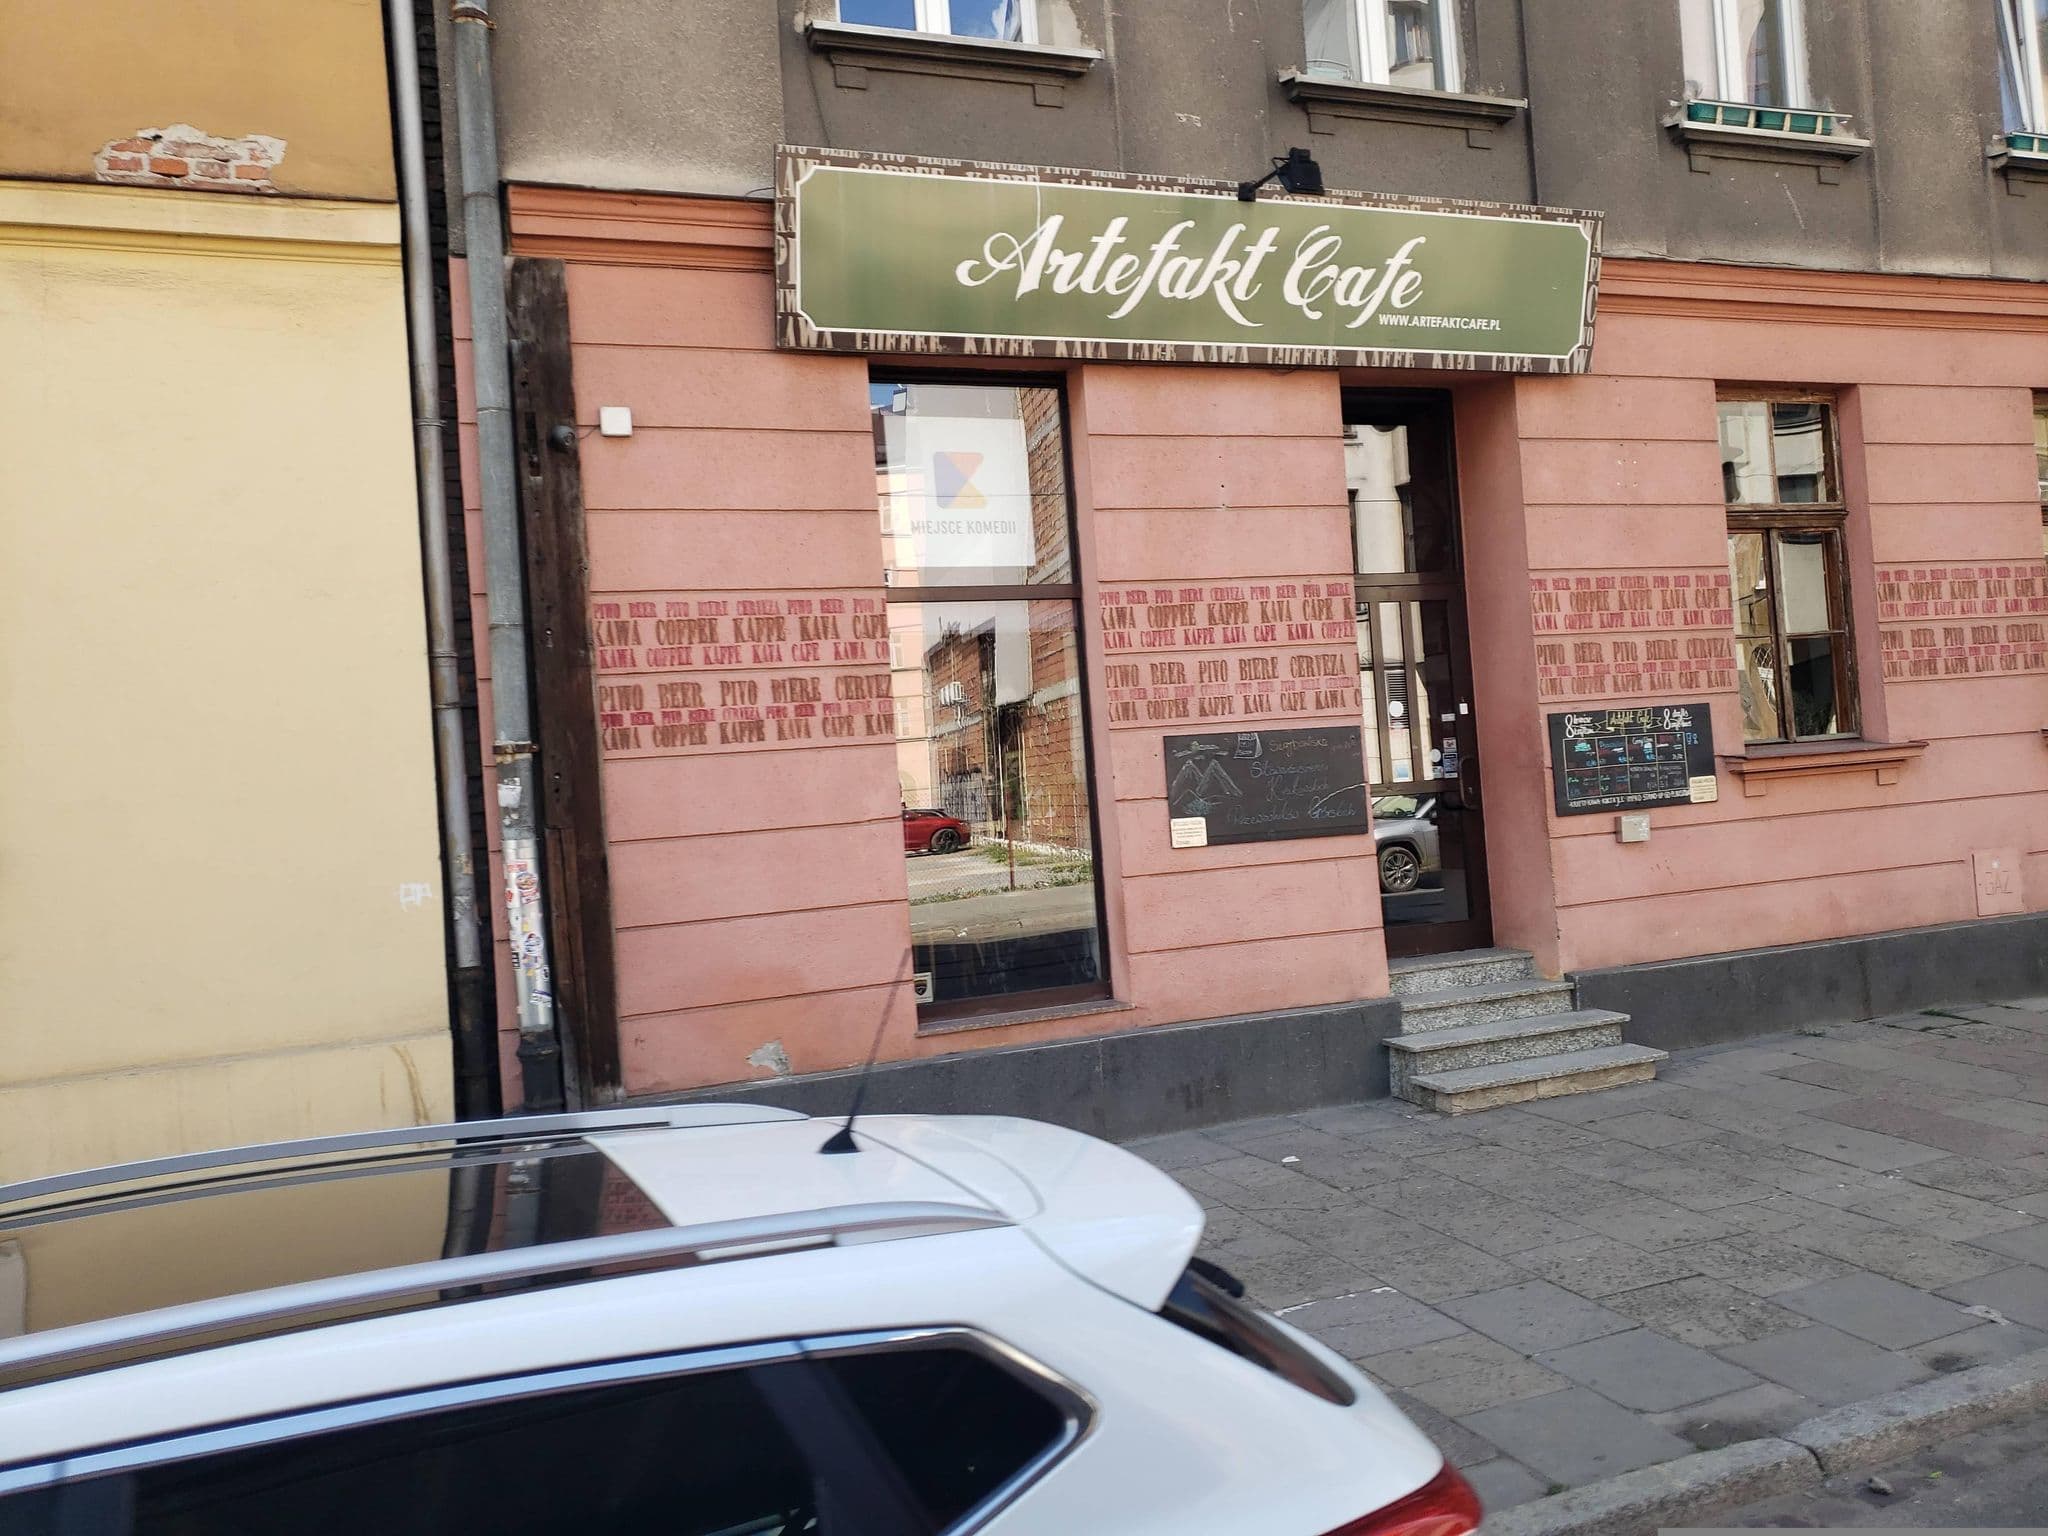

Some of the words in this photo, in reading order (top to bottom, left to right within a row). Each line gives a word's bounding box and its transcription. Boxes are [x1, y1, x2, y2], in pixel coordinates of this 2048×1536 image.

[955, 215, 1279, 327] Artefakt
[1284, 224, 1426, 329] Cafe
[1378, 313, 1502, 331] WWW.ARTEFAKTCAFE.PL
[911, 521, 963, 535] MIEJSCE
[966, 521, 1017, 535] KOMEDII
[1105, 663, 1139, 688] PIWO
[1150, 661, 1186, 686] BEER
[1199, 659, 1227, 683] PIVO
[1239, 657, 1279, 681] BIERE
[1290, 654, 1346, 678] CERVEZA
